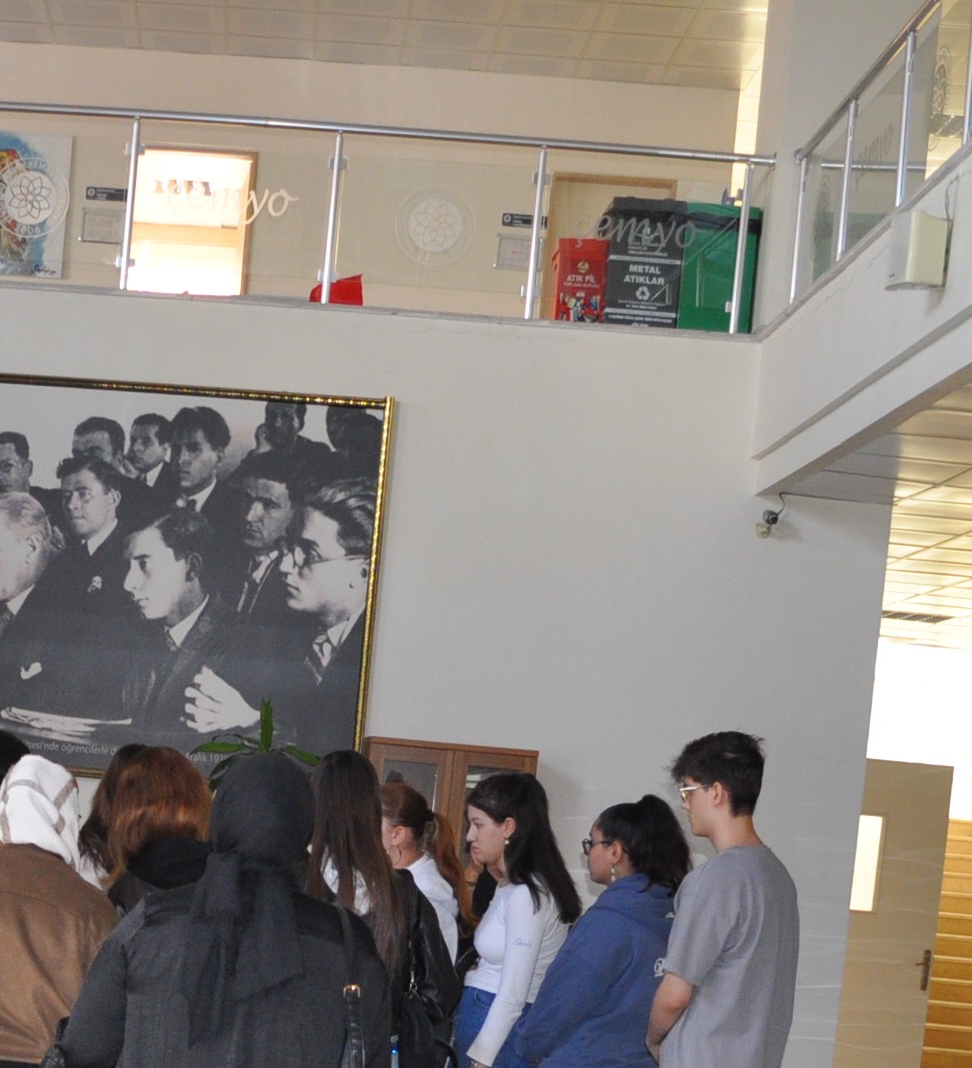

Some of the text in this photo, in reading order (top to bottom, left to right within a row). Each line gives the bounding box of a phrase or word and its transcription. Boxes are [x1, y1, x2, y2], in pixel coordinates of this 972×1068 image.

[629, 264, 661, 274] METAL
[566, 274, 583, 282] ATIK
[623, 274, 665, 286] ATIKLAR
[61, 743, 109, 755] öğrencilerle
